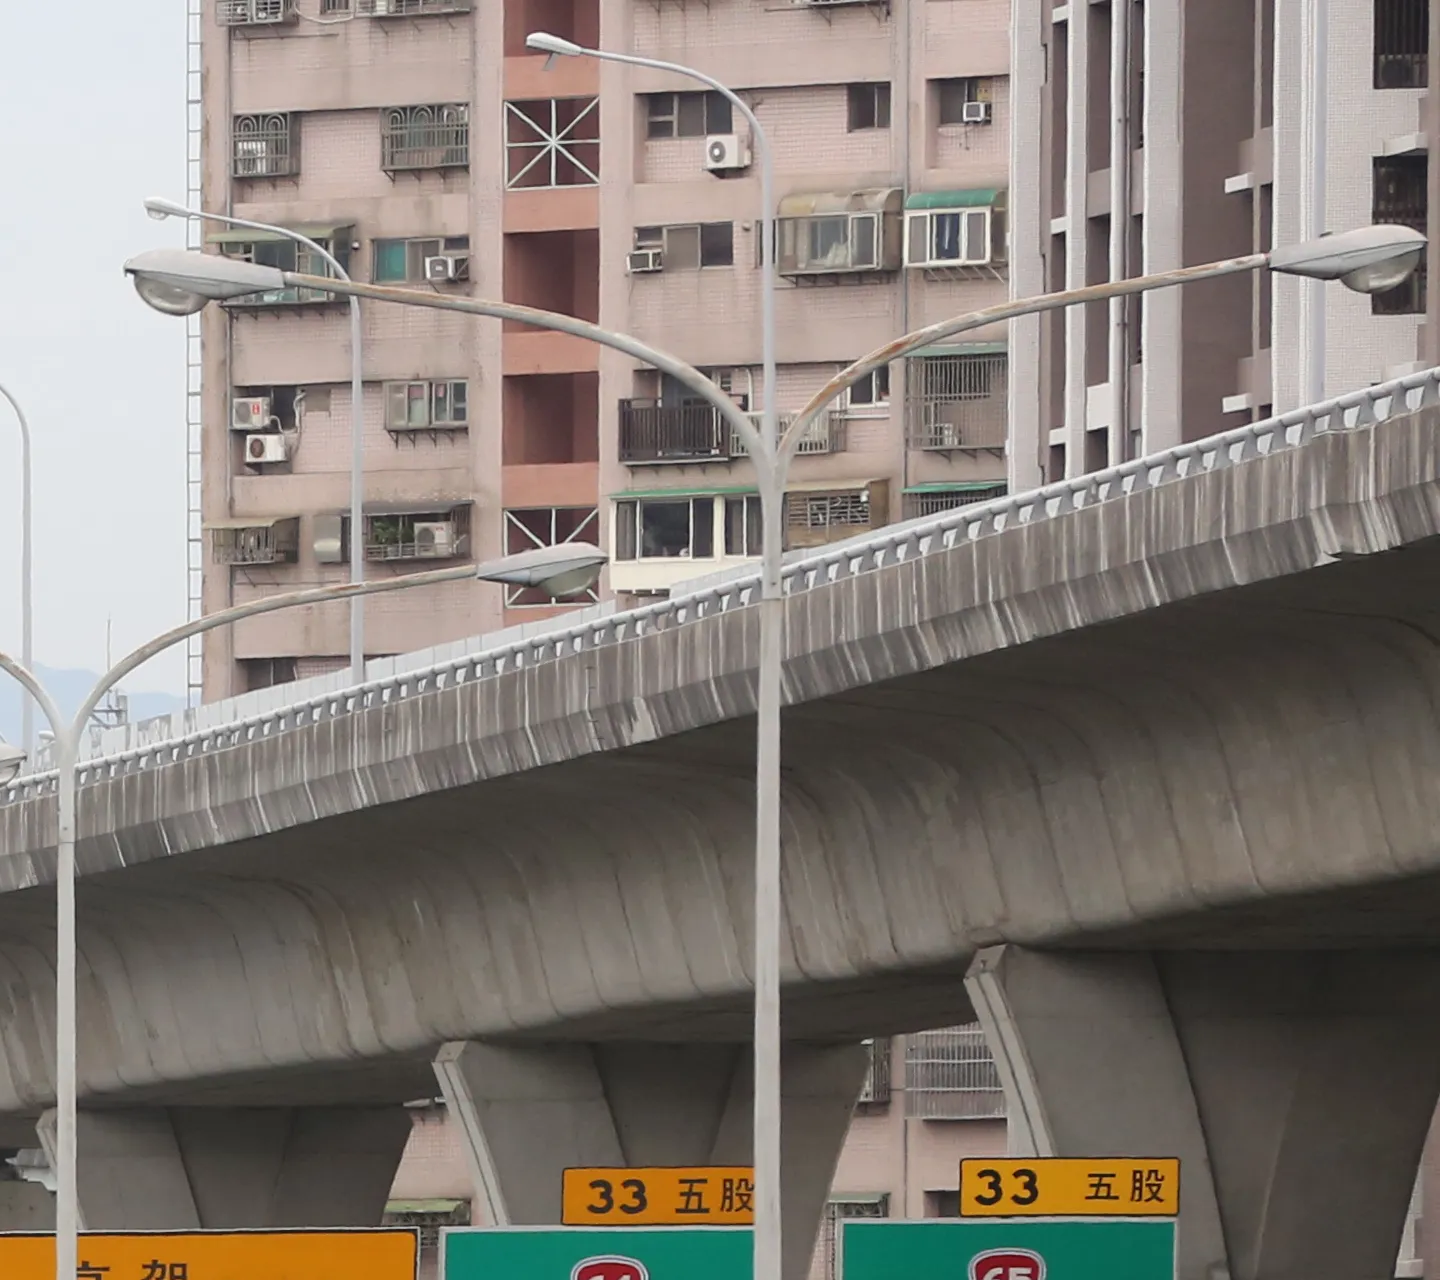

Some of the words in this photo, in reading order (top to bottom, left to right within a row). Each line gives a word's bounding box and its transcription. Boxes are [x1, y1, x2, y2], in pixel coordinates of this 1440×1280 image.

[587, 1179, 648, 1214] 33
[677, 1178, 755, 1212] 五股
[974, 1169, 1038, 1206] 33
[1084, 1169, 1166, 1204] 五股
